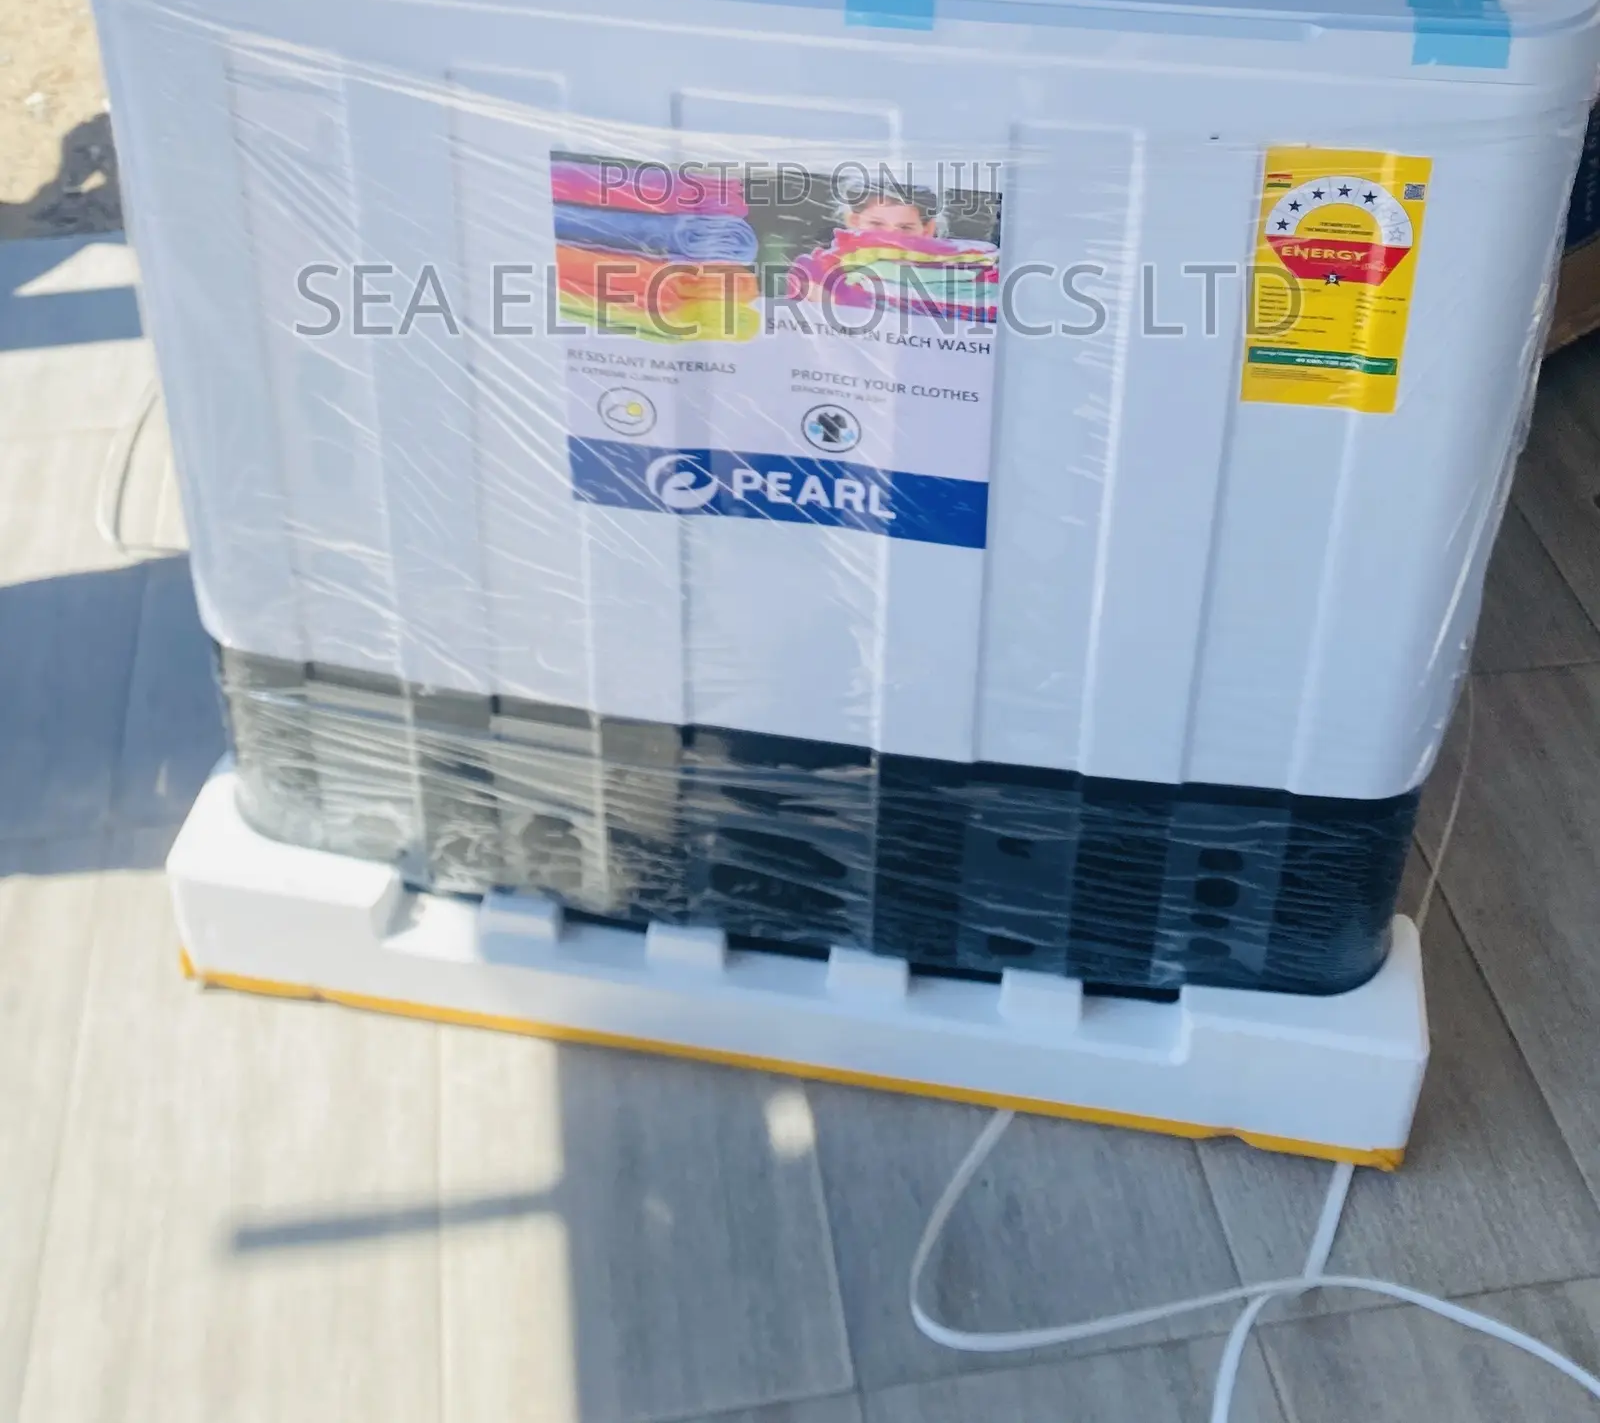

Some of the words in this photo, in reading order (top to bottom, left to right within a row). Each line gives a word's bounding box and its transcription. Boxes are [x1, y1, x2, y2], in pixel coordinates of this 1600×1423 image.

[1281, 244, 1368, 261] ENERGY
[767, 318, 811, 334] SAVE
[815, 322, 859, 339] TIME
[863, 327, 880, 343] IN
[886, 332, 931, 349] EACH
[937, 338, 991, 355] WASH
[567, 348, 645, 369] RESISTANT
[650, 359, 736, 374] MATERIALS
[791, 368, 858, 388] PROTECT
[863, 378, 906, 395] YOUR
[911, 384, 979, 403] CLOTHES
[731, 468, 896, 520] PEARL
